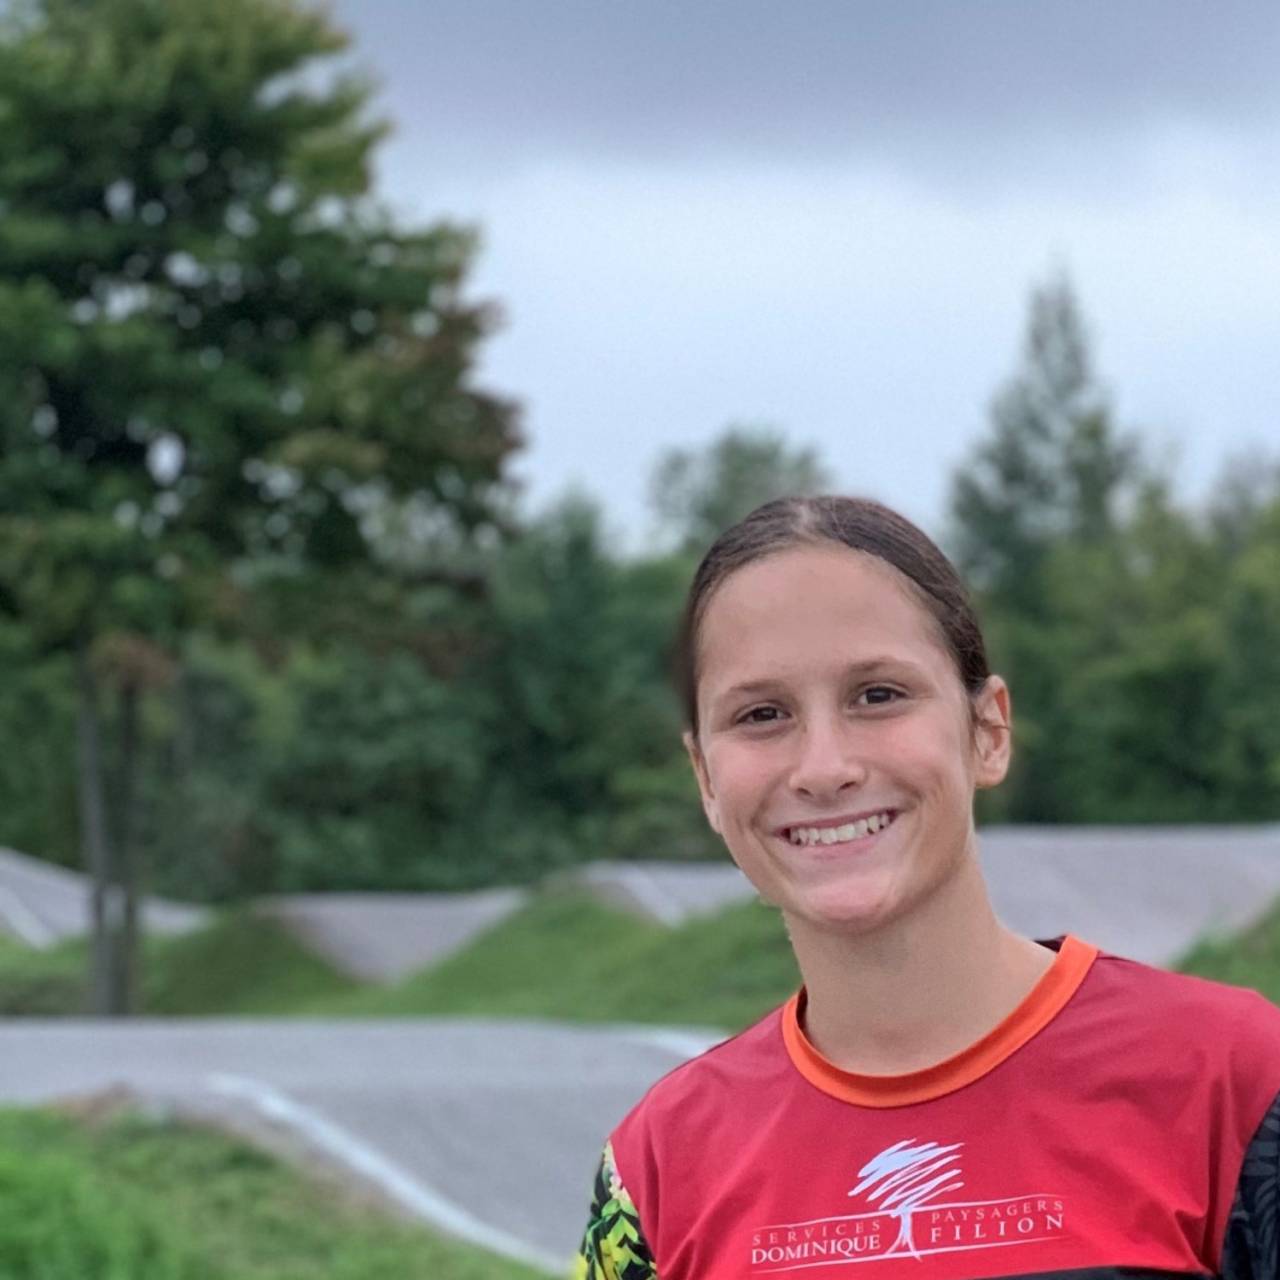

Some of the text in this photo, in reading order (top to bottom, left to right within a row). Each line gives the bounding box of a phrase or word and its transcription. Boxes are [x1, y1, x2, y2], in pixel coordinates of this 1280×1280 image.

[751, 1214, 1064, 1265] DOMINIQUE FILION
[752, 1200, 1064, 1246] SERVICES PAYSAGERS
